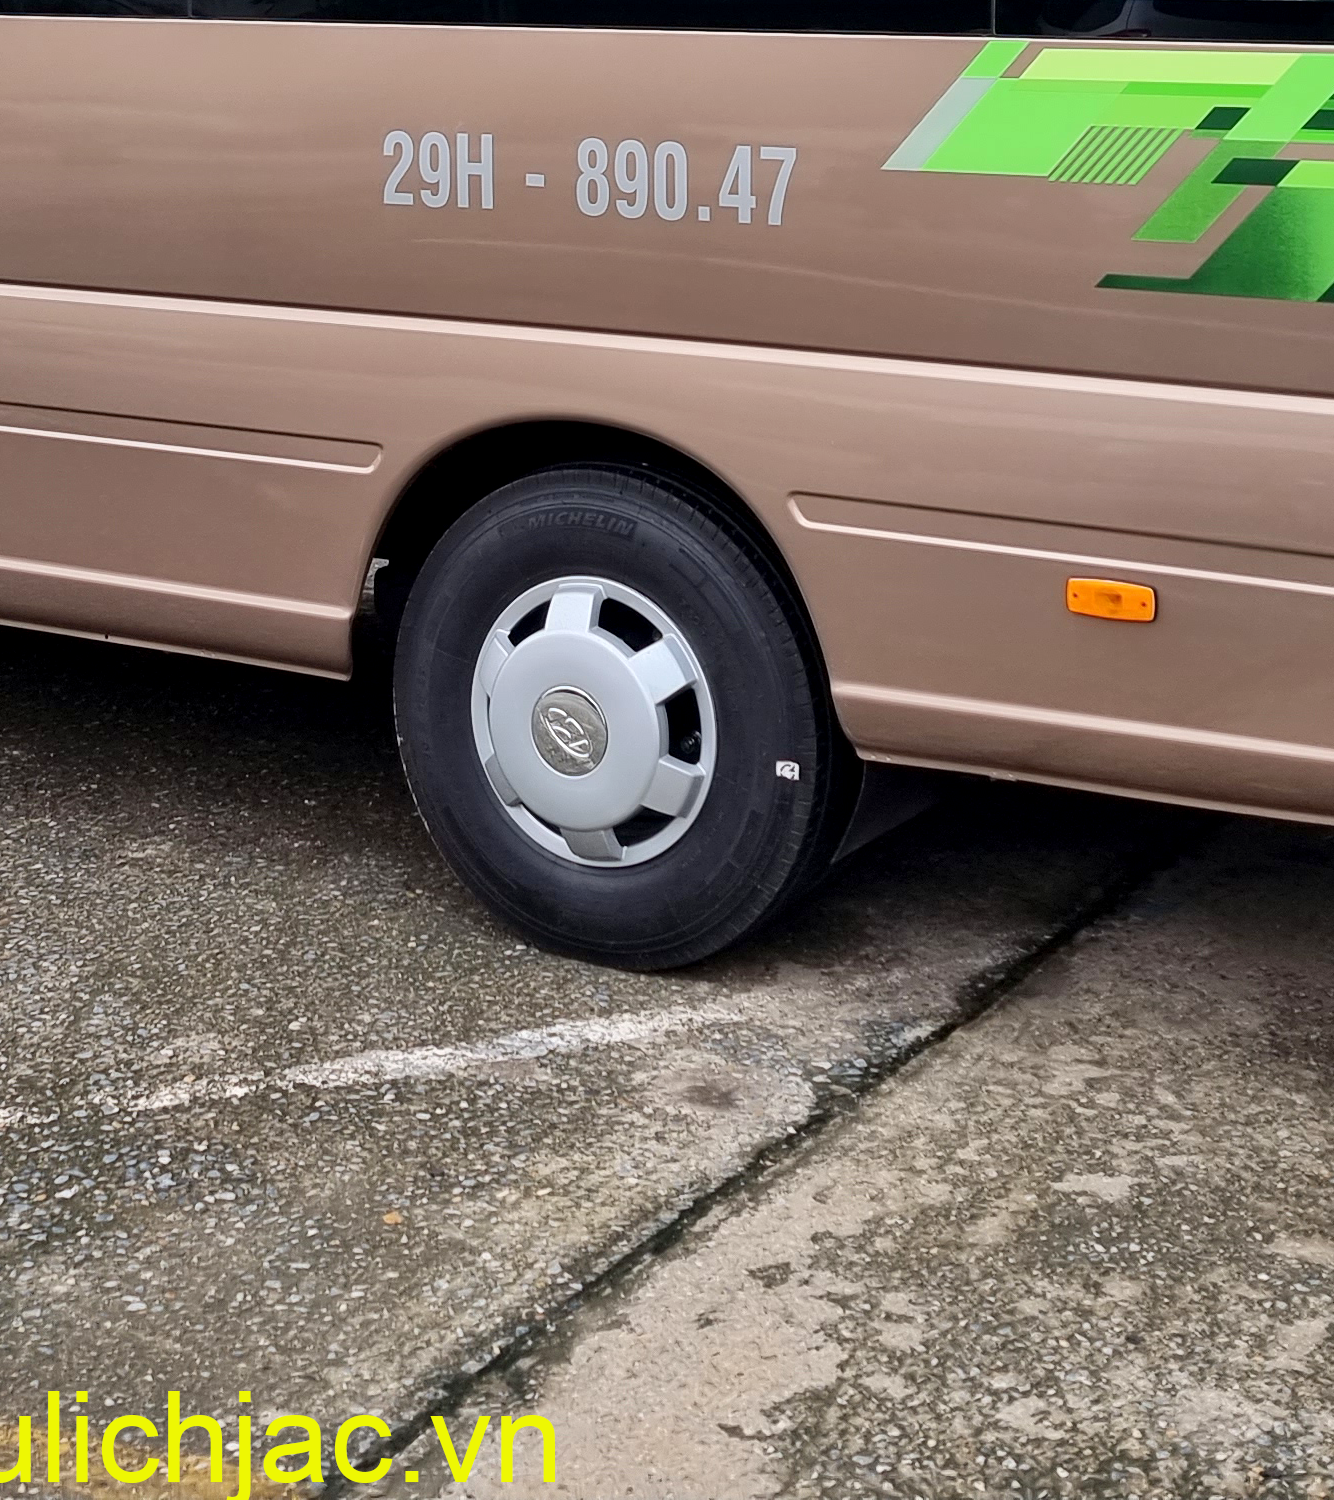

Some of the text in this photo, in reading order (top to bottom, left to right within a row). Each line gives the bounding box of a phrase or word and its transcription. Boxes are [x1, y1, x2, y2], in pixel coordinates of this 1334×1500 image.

[383, 129, 495, 210] 29H
[575, 137, 798, 227] 890.47
[527, 510, 635, 537] MICHELIN
